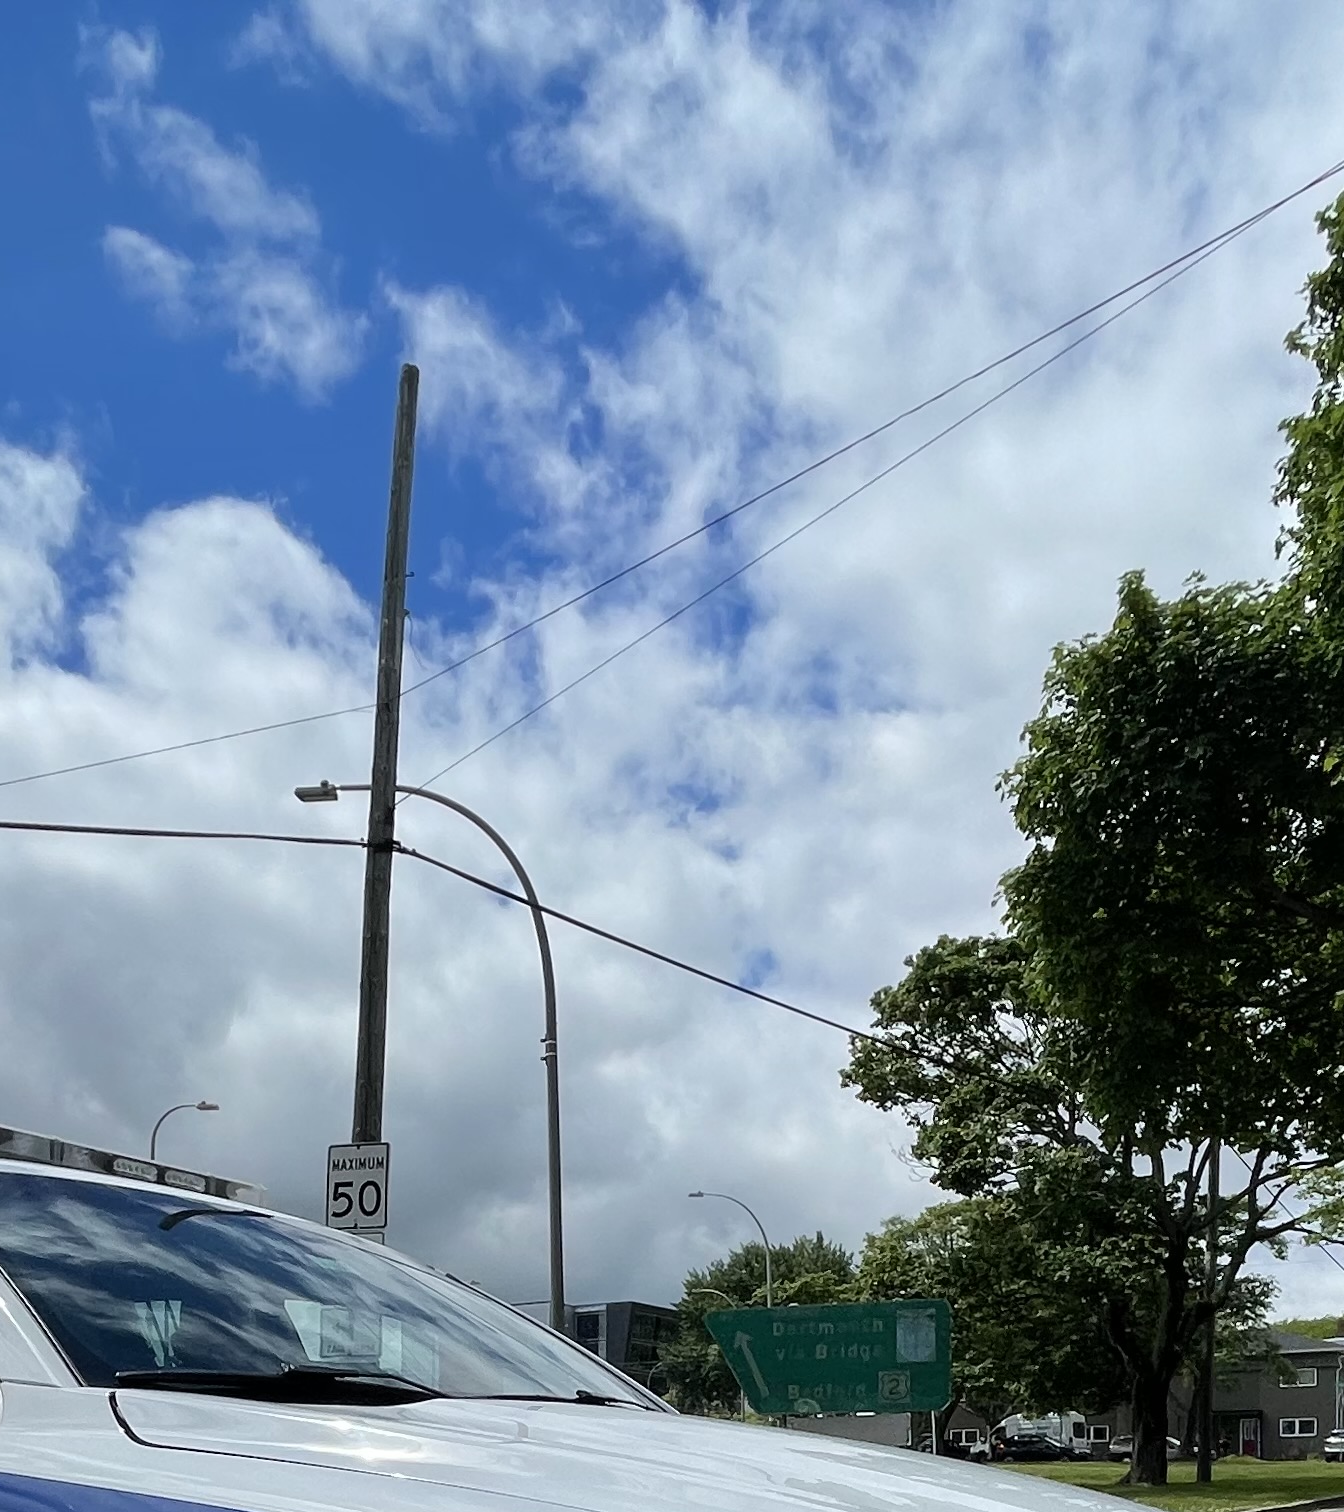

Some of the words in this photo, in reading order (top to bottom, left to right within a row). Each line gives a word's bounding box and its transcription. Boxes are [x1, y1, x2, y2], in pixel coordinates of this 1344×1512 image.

[332, 1157, 384, 1171] MAXIMUM
[331, 1180, 381, 1218] 50
[887, 1378, 901, 1396] 2
